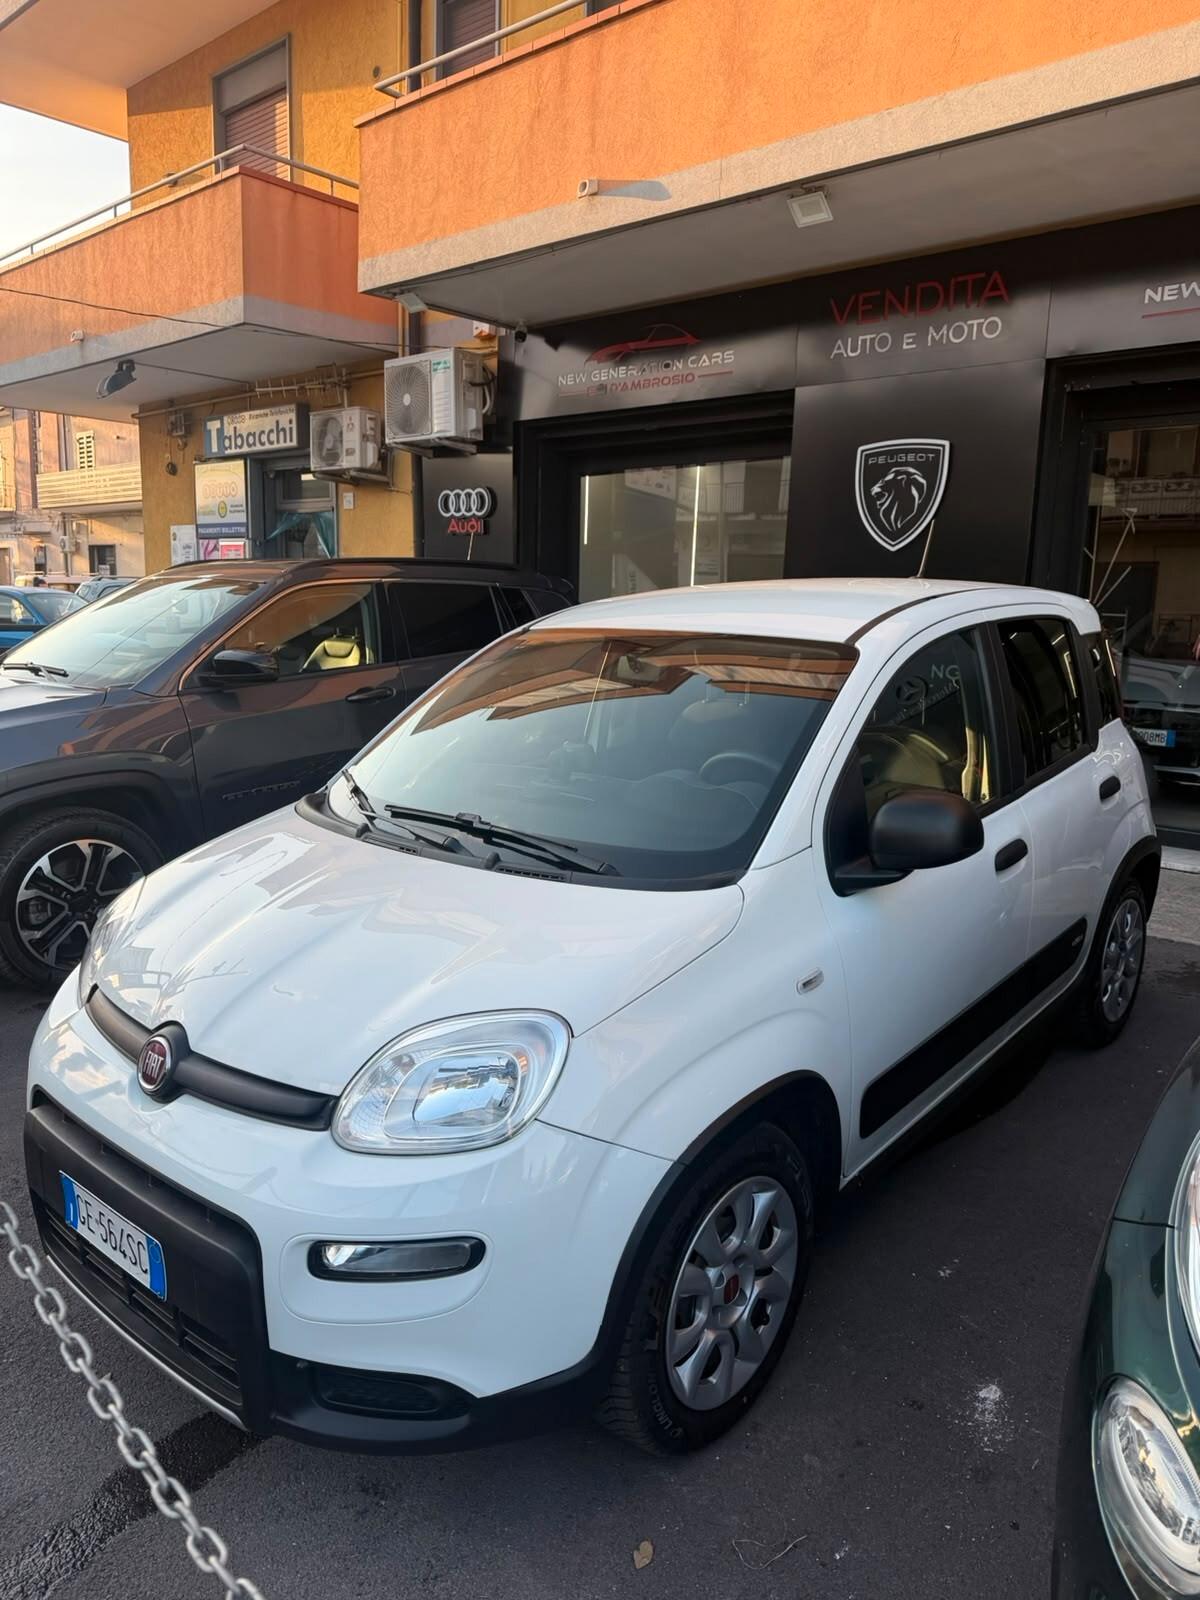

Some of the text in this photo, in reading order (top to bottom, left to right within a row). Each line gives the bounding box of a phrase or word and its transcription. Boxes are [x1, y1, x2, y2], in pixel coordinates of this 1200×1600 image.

[829, 270, 1010, 327] VENDITA
[1144, 281, 1200, 304] NEW
[830, 315, 1003, 359] AUTO E MOTO
[557, 349, 736, 388] NEW GENERATION CARS
[609, 372, 696, 394] D'AMBROSIO
[206, 418, 293, 453] Tabacchi
[868, 453, 936, 465] PEUGEOT
[143, 1050, 165, 1080] FIAT
